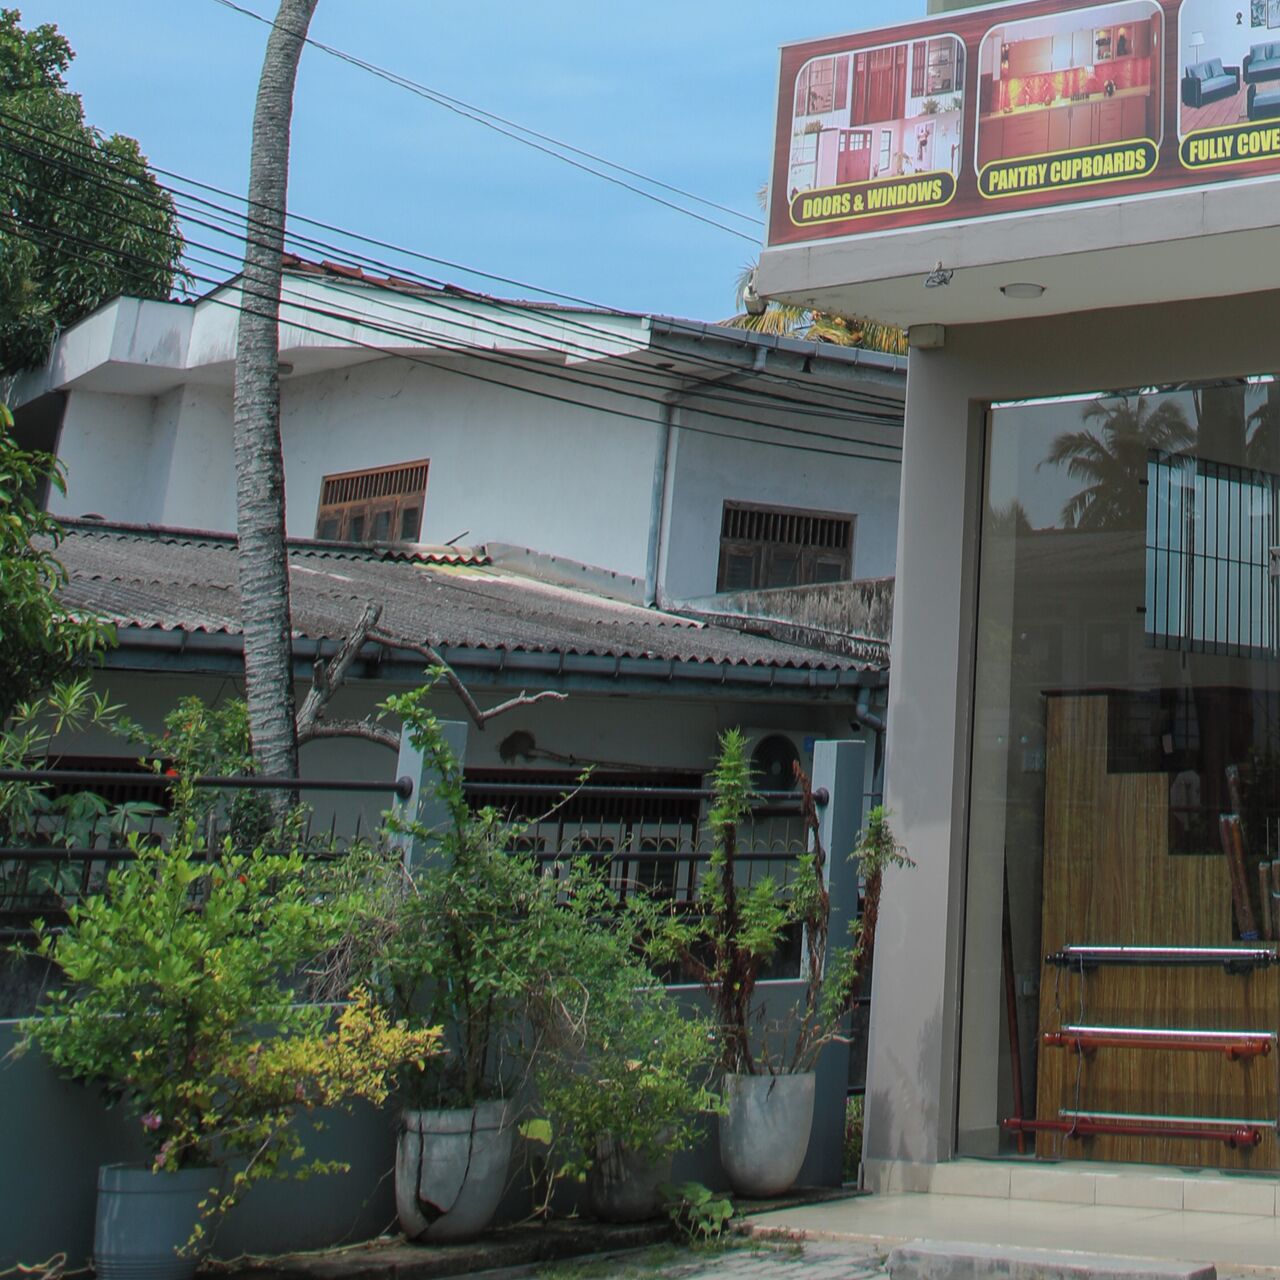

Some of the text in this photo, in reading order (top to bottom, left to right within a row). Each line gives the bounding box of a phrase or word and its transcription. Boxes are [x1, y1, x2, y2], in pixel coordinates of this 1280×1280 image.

[1189, 134, 1234, 163] FULLY
[988, 148, 1146, 192] PANTRY CUPBOARDS
[802, 179, 942, 219] DOORS & WINDOWS
